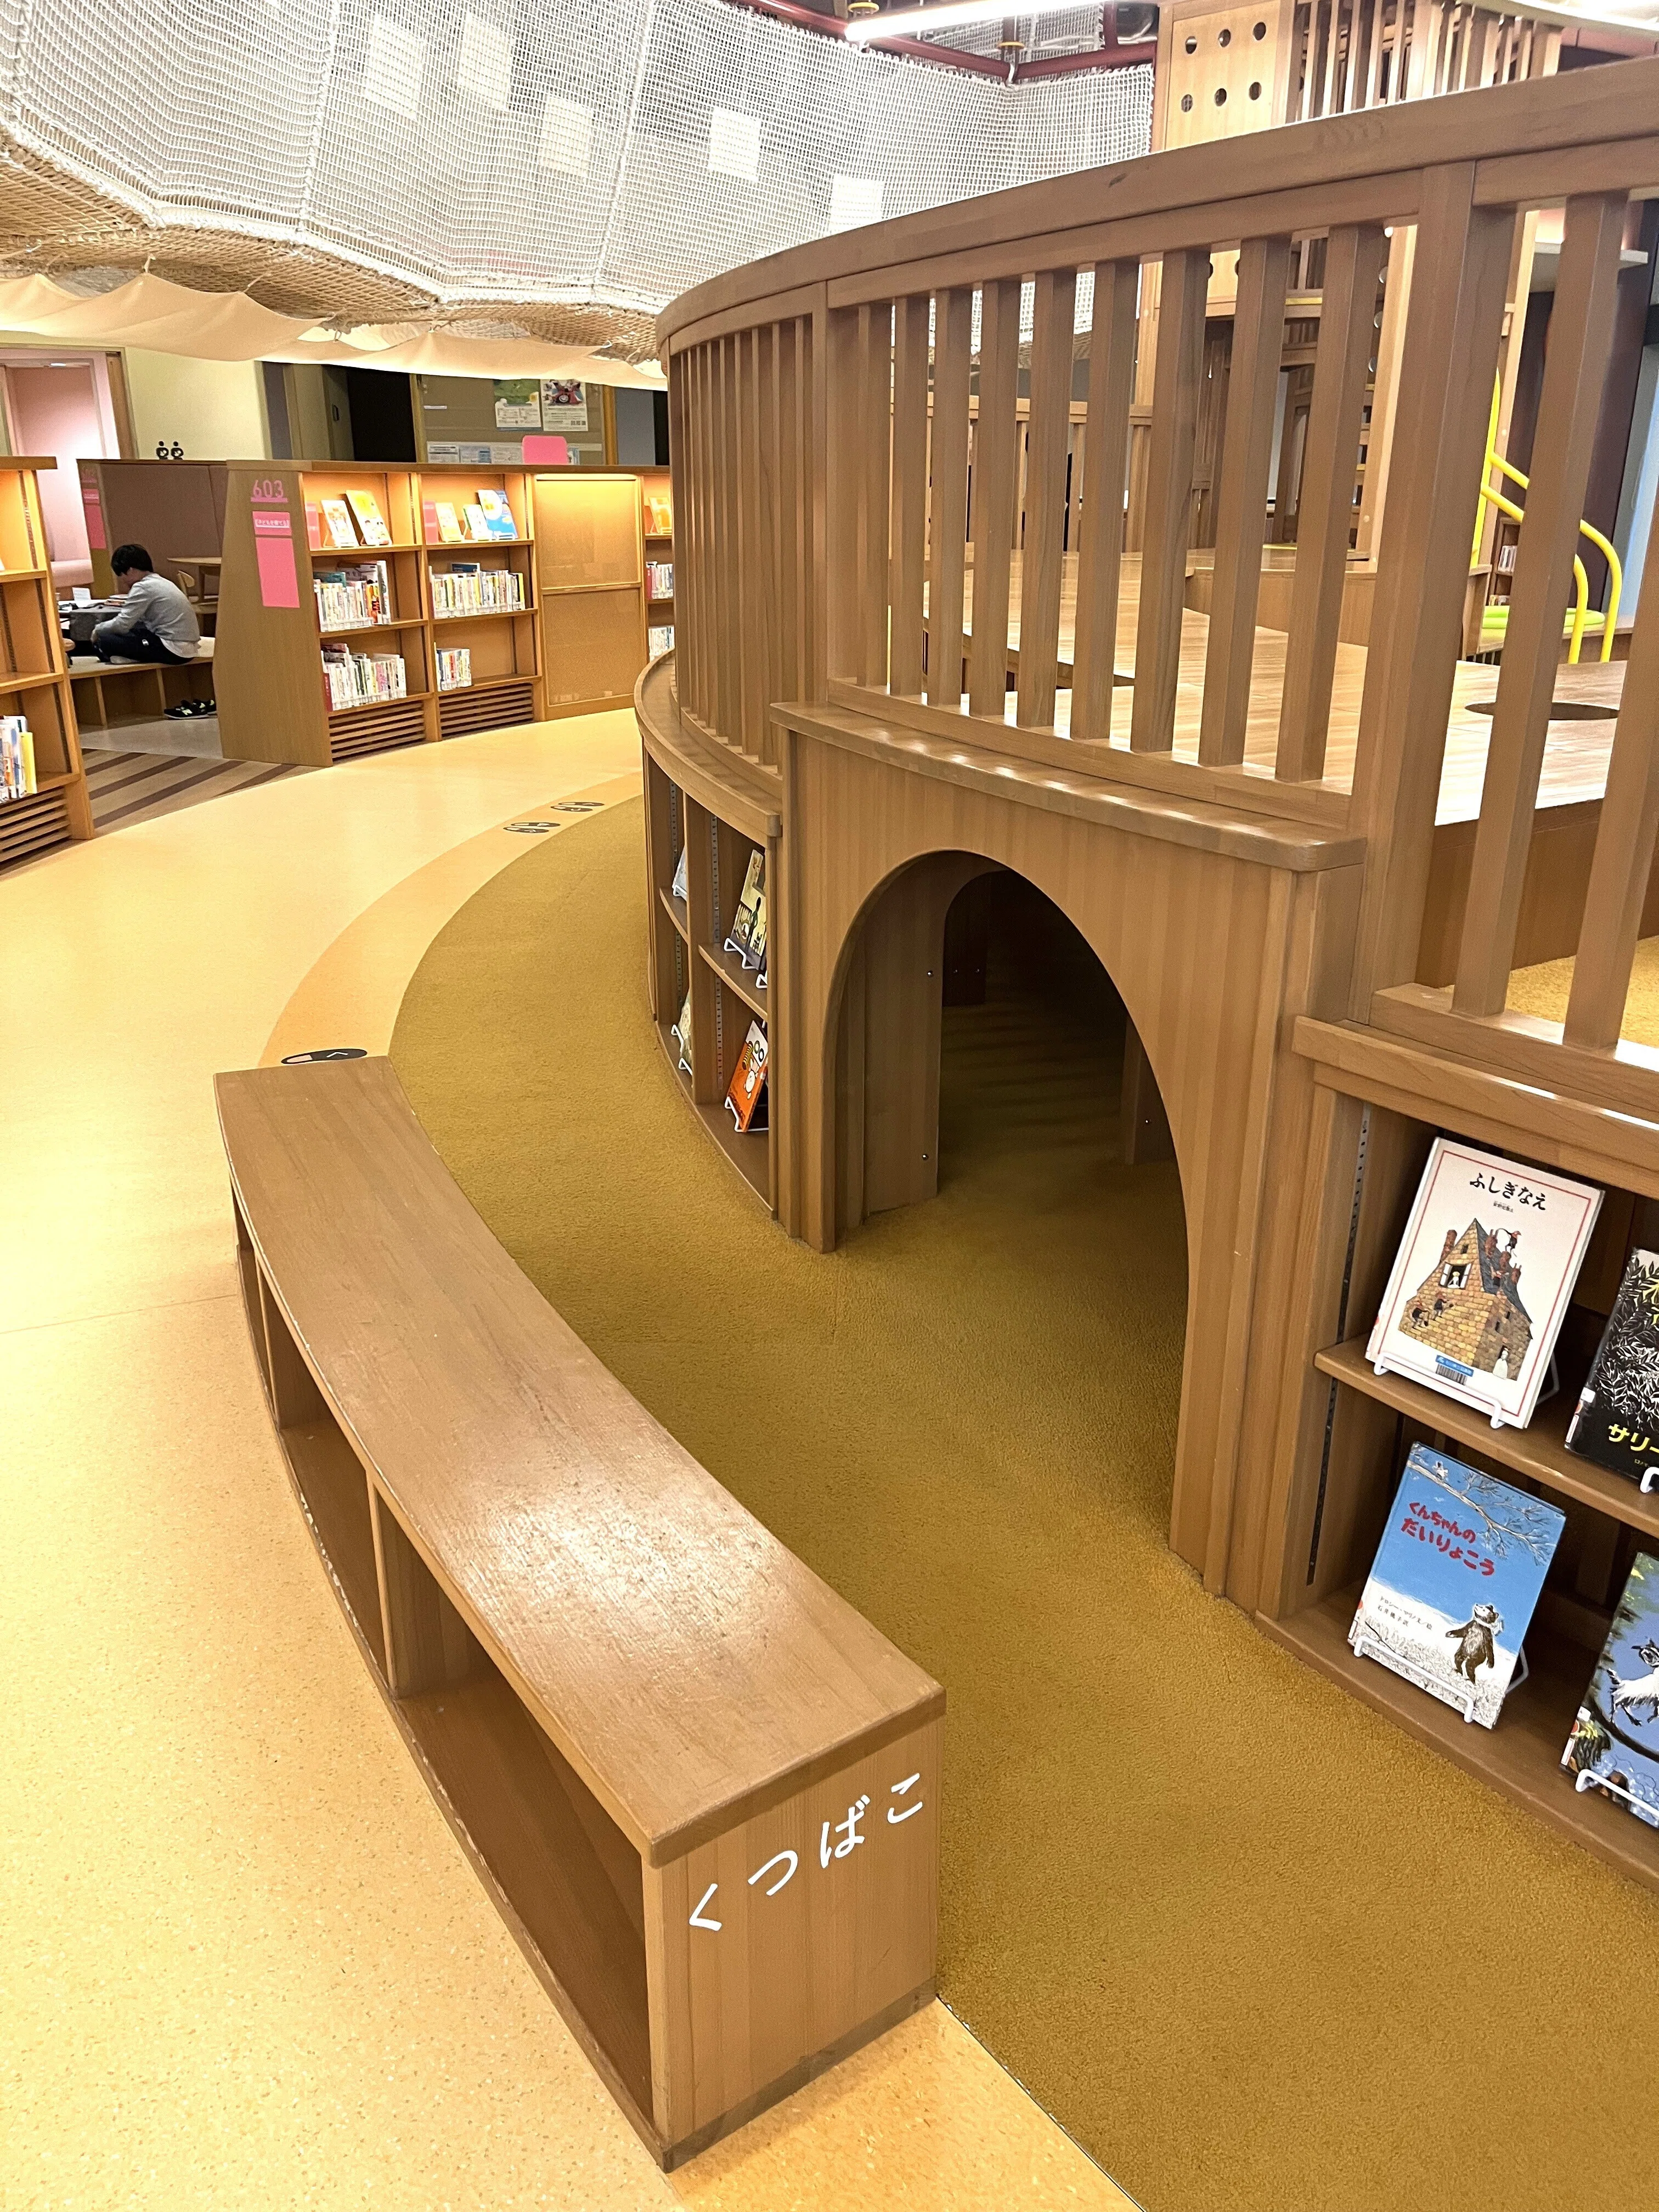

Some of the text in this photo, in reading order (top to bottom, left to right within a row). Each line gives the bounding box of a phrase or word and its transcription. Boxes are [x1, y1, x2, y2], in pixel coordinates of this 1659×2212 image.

[253, 478, 284, 499] 603
[1469, 1172, 1546, 1211] ふしぎなえ
[1409, 1502, 1476, 1544] くんちゃんの
[1400, 1517, 1495, 1576] だいりょこう
[689, 1772, 923, 1932] くつばこ
